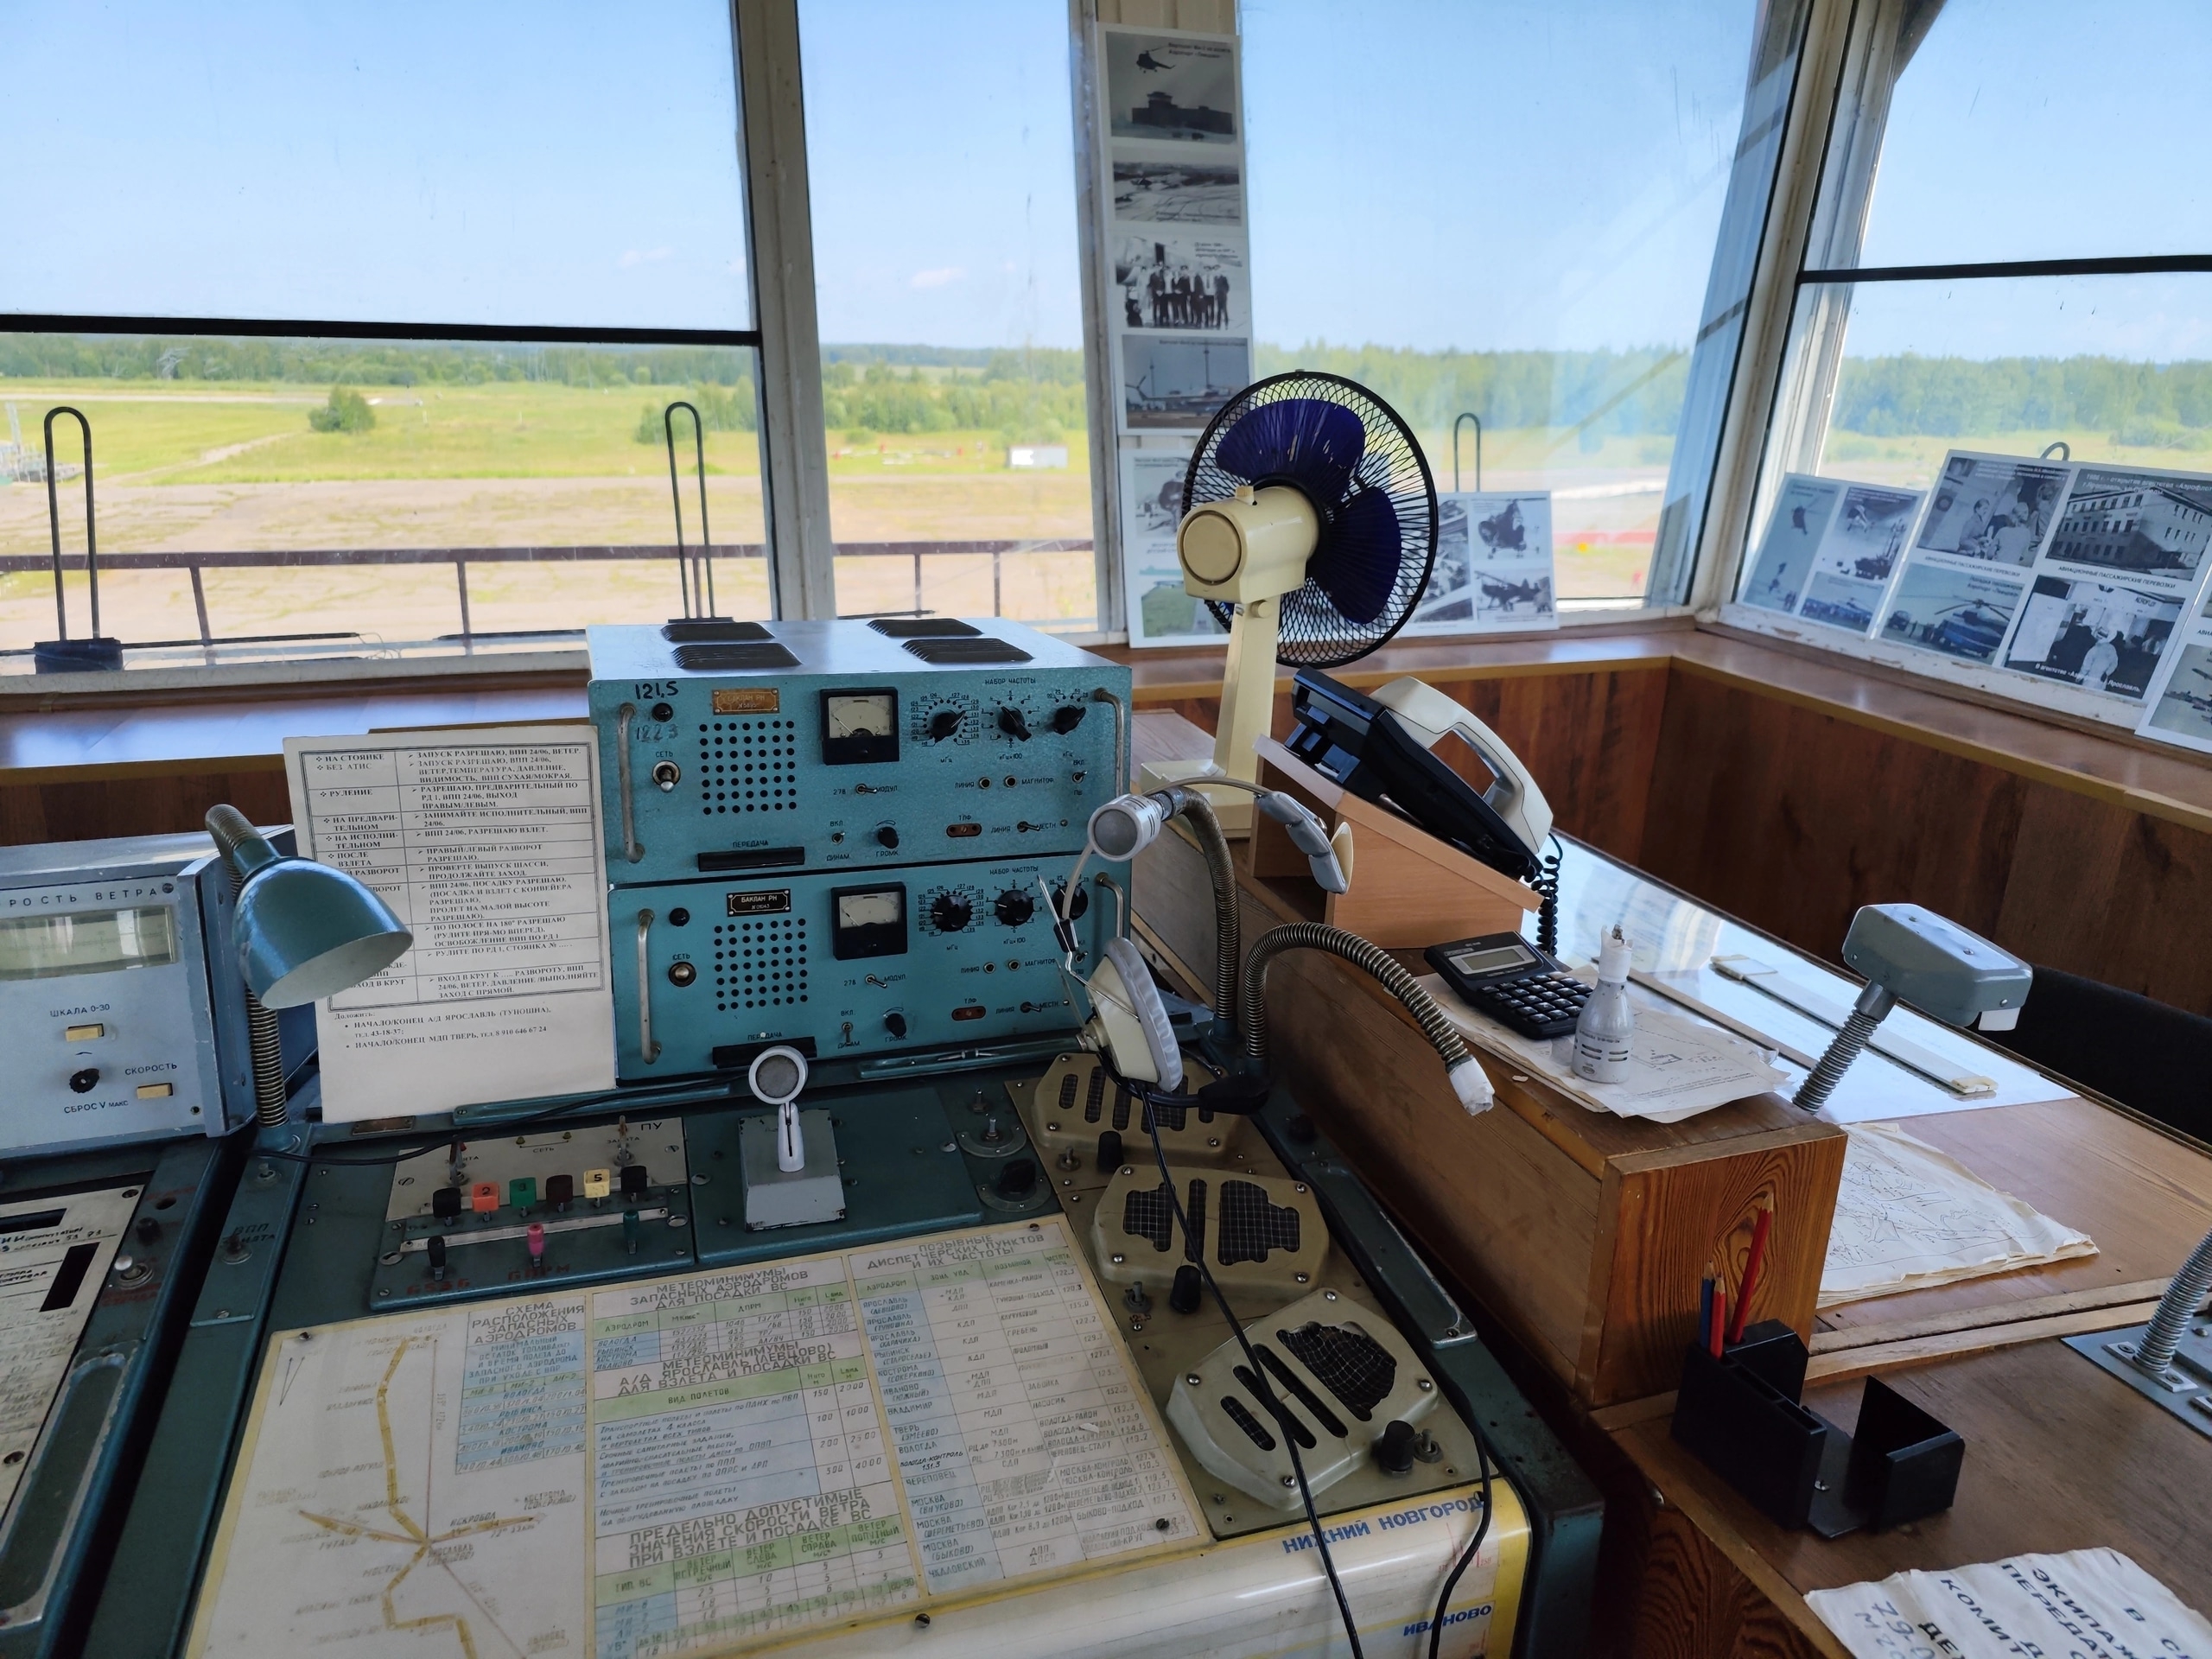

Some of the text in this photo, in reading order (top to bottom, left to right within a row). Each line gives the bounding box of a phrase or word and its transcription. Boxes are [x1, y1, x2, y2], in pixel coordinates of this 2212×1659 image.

[2058, 566, 2176, 589] АВИАЦИОННЫЕ ПАССАЖИРСКИЕ ПЕРЕВОЗКИ
[475, 782, 563, 791] ПРЕДВАРИТЕЛЬНЫЙ
[423, 810, 478, 819] ЗАНИМАЙТЕ
[991, 825, 1011, 834] ЛИНИЯ
[426, 843, 542, 855] ПРАВЫЙ/ЛЕВЫЙ РАЗВОРОТ
[429, 871, 496, 880] ПРОДОЛЖАЙТЕ
[0, 888, 156, 907] РОСТЬ ВЕТРА
[480, 900, 550, 911] МАЛОЙ ВЫСОТЕ
[435, 943, 546, 957] РУЛИТЕ СТОЯНКА
[437, 974, 461, 982] ВХОД
[50, 1003, 111, 1018] ШКАЛА 0-30
[445, 1011, 496, 1021] ЯРОСЛАВЛЬ
[429, 1033, 448, 1043] МДП
[124, 1062, 178, 1076] СКОРОСТЬ
[64, 1103, 97, 1114] СБРОС
[641, 1122, 662, 1131] ПУ
[918, 1235, 993, 1252] ПОЗЫВНЫЕ
[868, 1235, 1045, 1269] ДИСПЕТЧЕРСКИХ ПУНКТОВ
[952, 1247, 1014, 1262] ЧАСТОТЫ
[630, 1270, 809, 1306] ЗАПАСНЫХ АЭРОДРОМОВ
[656, 1268, 786, 1294] МЕТЕОМИНИМУМЫ
[655, 1282, 788, 1310] ДЛЯ ПОСАДКИ ВС
[505, 1301, 554, 1315] СХЕМА
[472, 1305, 584, 1329] РАСПОЛОЖЕНИЯ
[488, 1315, 568, 1334] ЗАПАСНЫХ
[474, 1322, 576, 1344] АЭРОДРОМОВ
[662, 1342, 798, 1370] МЕТЕОМИНИМУМЫ
[620, 1343, 832, 1386] А/Д ЯРОСЛАВЛЬ (ЛЕВЦОВО)
[878, 1364, 918, 1376] КОСТРОМА
[618, 1357, 811, 1396] ДЛЯ ВЗЛЕТА ПОСАДКИ
[883, 1383, 918, 1395] ИВАНОВО
[668, 1388, 729, 1405] ВИД ПОЛЕТОВ
[887, 1402, 932, 1415] ВЛАДИМИР
[894, 1424, 920, 1434] ТВЕРЬ
[899, 1441, 938, 1453] ВОЛОГДА
[906, 1471, 957, 1486] ЧЕРЕПОВЕЦ
[912, 1495, 945, 1507] МОСКВА
[629, 1488, 864, 1544] ПРЕДЕЛЬНО ДОПУСТИМЫЕ
[917, 1516, 951, 1529] МОСКВА
[629, 1498, 871, 1556] ЗНАЧЕНИЯ СКОРОСТИ ВЕТРА
[629, 1509, 872, 1568] ПРИ ВЗЛЕТЕ ПОСАДКЕ ВС
[801, 1531, 830, 1544] ВЕТЕР
[801, 1539, 837, 1553] СПРАВА
[923, 1538, 959, 1552] МОСКВА
[928, 1557, 986, 1578] ЧКАЛОВСКИЙ
